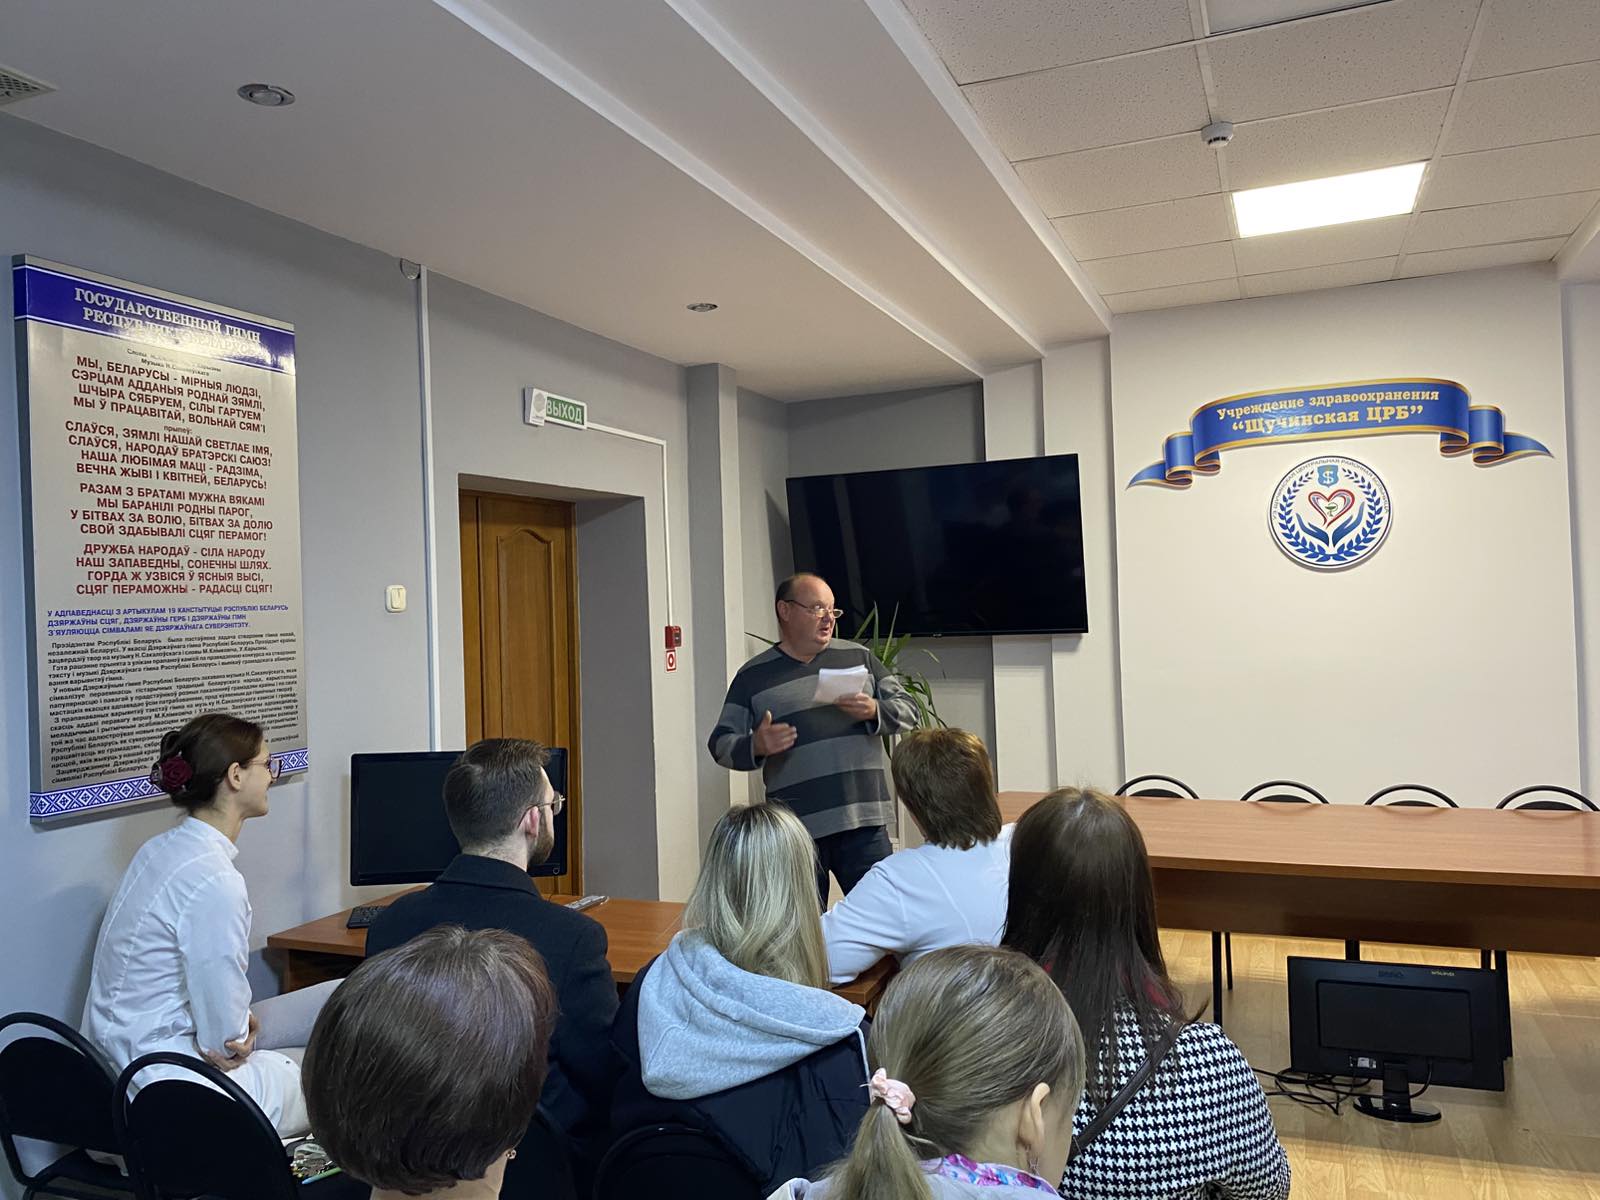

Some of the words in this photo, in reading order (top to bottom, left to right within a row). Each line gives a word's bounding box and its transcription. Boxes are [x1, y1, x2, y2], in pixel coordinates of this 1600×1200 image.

[75, 287, 222, 333] ГОСУДАРСТВЕННЫЙ
[225, 324, 260, 343] ГИМН
[71, 368, 124, 387] СЭРЦАМ
[127, 378, 184, 397] АДДАНЫЯ
[186, 388, 229, 404] РОДНАЙ
[231, 396, 266, 412] ЗЯМЛІ,
[77, 355, 103, 372] МЫ,
[107, 361, 170, 383] БЕЛАРУСЫ
[181, 375, 222, 392] МІРНЫЯ
[225, 383, 261, 400] ЛЮДЗІ,
[73, 395, 96, 409] МЫ
[98, 397, 107, 410] Ў
[110, 401, 185, 423] ПРАЦАВІТАЙ,
[188, 413, 237, 429] ВОЛЬНАЙ
[79, 383, 125, 400] ШЧЫРА
[128, 391, 186, 411] СЯБРУЕМ,
[189, 400, 215, 415] СІЛЫ
[218, 405, 261, 421] ГАРТУЕМ
[546, 399, 583, 424] ВЫХОД
[1217, 398, 1304, 420] Учреждение
[1309, 391, 1439, 407] здравоохранения
[65, 420, 119, 439] СЛАЎСЯ,
[122, 427, 160, 442] ЗЯМЛІ
[163, 433, 203, 447] НАШАЙ
[205, 438, 250, 453] СВЕТЛАЕ
[252, 444, 273, 458] ІМЯ,
[68, 434, 125, 453] СЛАЎСЯ,
[125, 441, 179, 457] НАРОДАЎ
[181, 447, 237, 463] БРАТЭРСКІ
[239, 454, 271, 467] САЮЗ!
[76, 462, 117, 476] ВЕЧНА
[120, 466, 152, 479] ЖЫВІ
[163, 470, 211, 486] КВІТНЕЙ,
[213, 475, 267, 490] БЕЛАРУСЬ!
[81, 449, 118, 464] НАША
[120, 454, 177, 471] ЛЮБІМАЯ
[179, 460, 206, 475] МАЦІ
[216, 464, 263, 479] РАДЗІМА,
[79, 482, 122, 496] РАЗАМ
[125, 486, 134, 497] З
[137, 487, 186, 501] БРАТАМІ
[188, 491, 227, 504] МУЖНА
[228, 494, 265, 506] ВЯКАМІ
[96, 497, 118, 509] МЫ
[122, 499, 174, 513] БАРАНІЛІ
[177, 503, 216, 516] РОДНЫ
[218, 506, 253, 519] ПАРОГ,
[80, 523, 115, 535] СВОЙ
[118, 525, 185, 538] ЗДАБЫВАЛІ
[188, 528, 215, 541] СЦЯГ
[218, 530, 267, 541] ПЕРАМОГ!
[82, 510, 125, 524] БІТВАХ
[128, 512, 145, 525] ЗА
[147, 513, 186, 528] ВОЛЮ,
[189, 516, 225, 528] БІТВАХ
[227, 518, 241, 529] ЗА
[243, 519, 273, 531] ДОЛЮ
[76, 556, 105, 570] НАШ
[108, 557, 184, 571] ЗАПАВЕДНЫ,
[187, 559, 237, 571] СОНЕЧНЫ
[239, 560, 272, 570] ШЛЯХ.
[83, 543, 135, 557] ДРУЖБА
[138, 545, 190, 558] НАРОДАЎ
[200, 547, 225, 559] СІЛА
[227, 548, 266, 560] НАРОДУ
[76, 584, 109, 596] СЦЯГ
[112, 583, 188, 594] ПЕРАМОЖНЫ
[199, 584, 242, 595] РАДАСЦІ
[245, 584, 273, 594] СЦЯГ!
[87, 570, 128, 583] ГОРДА
[130, 571, 142, 581] Ж
[145, 571, 185, 582] УЗВІСЯ
[188, 571, 195, 582] Ў
[197, 571, 234, 582] ЯСНЫЯ
[236, 572, 264, 583] ВЫСІ,
